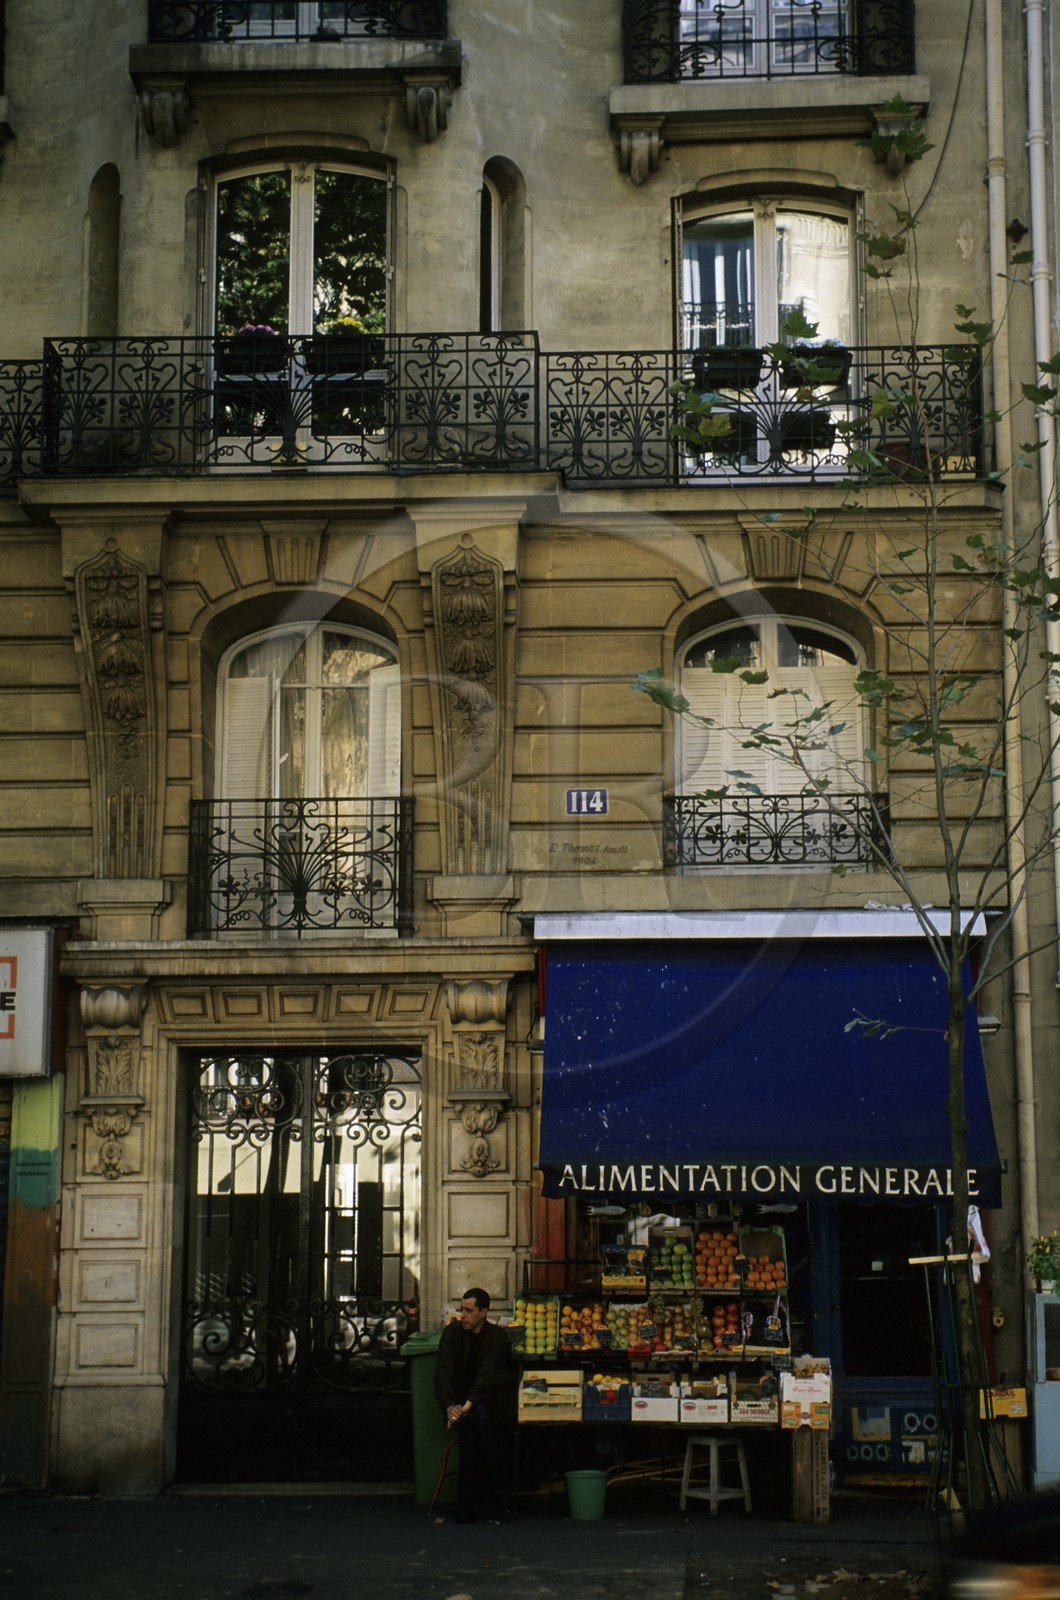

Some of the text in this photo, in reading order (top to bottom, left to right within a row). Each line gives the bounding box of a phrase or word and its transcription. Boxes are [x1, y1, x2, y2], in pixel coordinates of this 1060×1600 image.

[570, 791, 603, 812] 114
[572, 856, 597, 865] 1904
[558, 1164, 980, 1196] ALIMENTATION GENERALE
